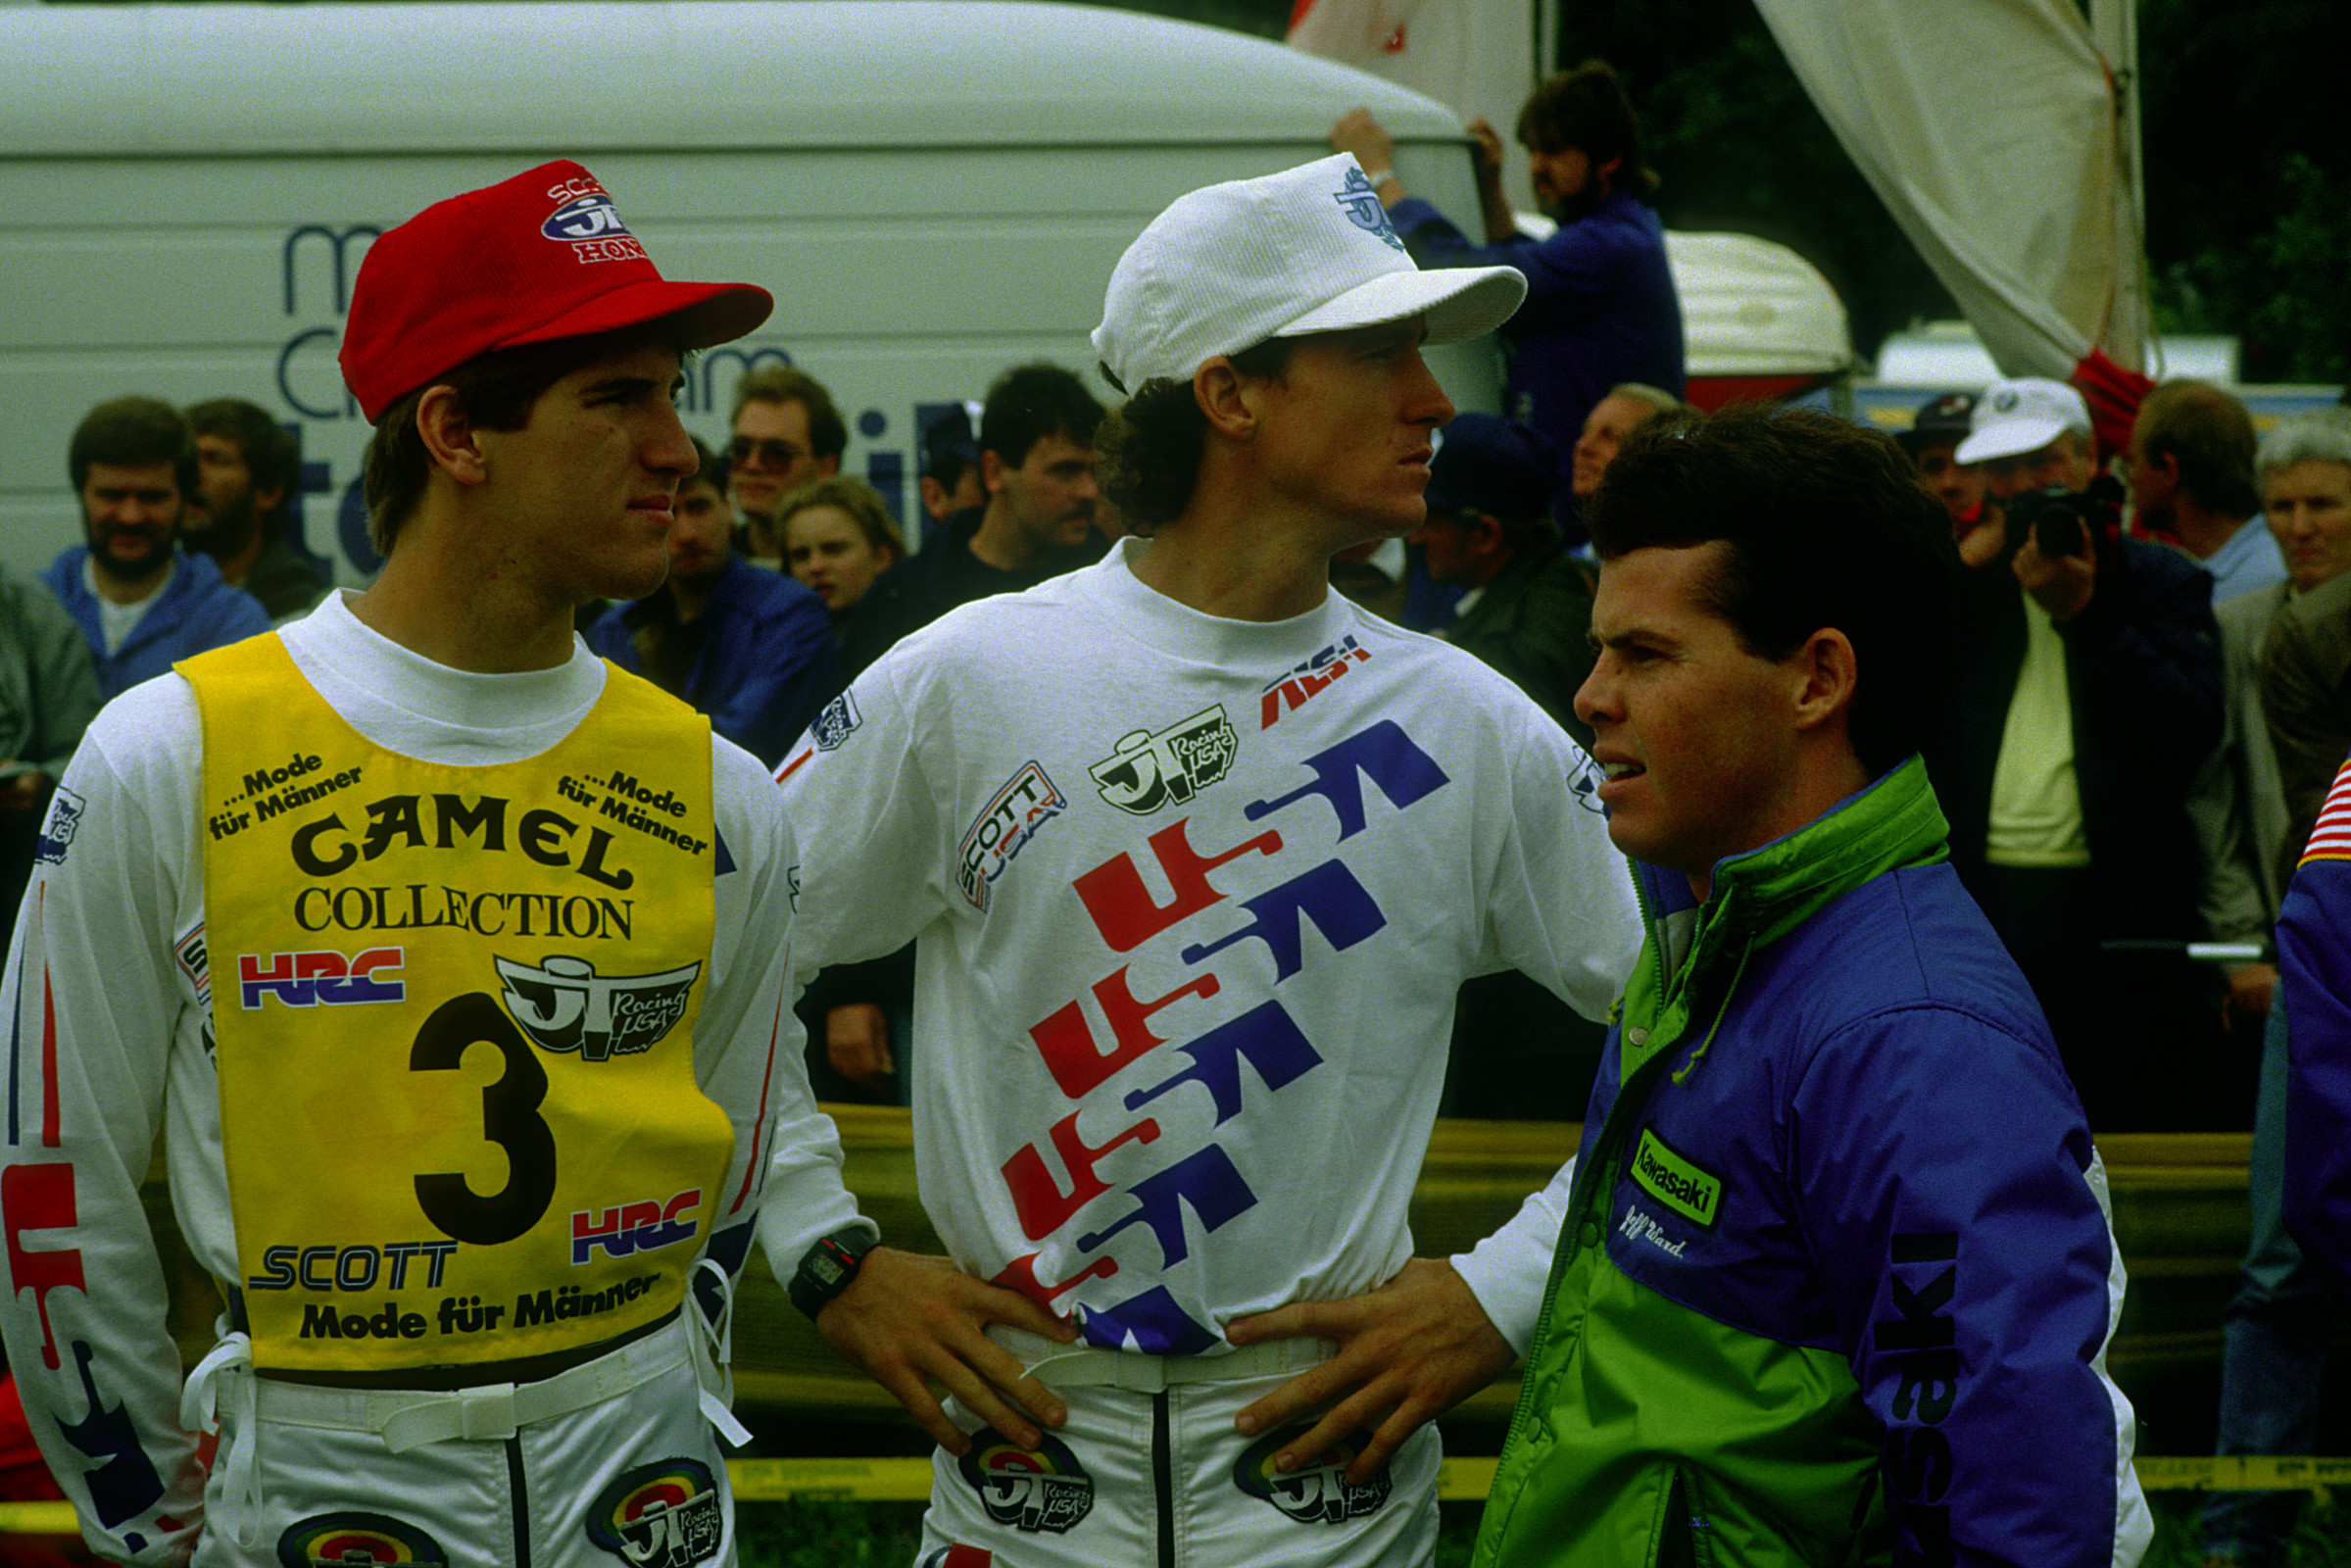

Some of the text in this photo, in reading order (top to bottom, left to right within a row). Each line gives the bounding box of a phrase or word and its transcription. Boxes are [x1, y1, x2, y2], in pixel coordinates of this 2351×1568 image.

[1171, 725, 1237, 760] Racing
[1190, 739, 1229, 770] USA
[209, 766, 362, 841] für Männer
[558, 775, 708, 856] für Männer
[960, 774, 1037, 896] SCOTT
[1073, 718, 1450, 952] USA
[292, 794, 634, 891] CAMEL
[982, 808, 1060, 882] USA
[295, 884, 634, 941] COLLECTION
[238, 946, 407, 1010] HRC
[613, 991, 689, 1019] Racing
[1029, 858, 1387, 1099] USA
[619, 1006, 669, 1035] USA
[409, 992, 557, 1246] 3
[1001, 999, 1324, 1242] USA
[1637, 1140, 1712, 1213] Kawasaki
[571, 1187, 703, 1266] HRC
[1619, 1204, 1650, 1241] Jeff
[249, 1240, 459, 1293] SCOTT
[300, 1271, 662, 1340] Mode für Männer
